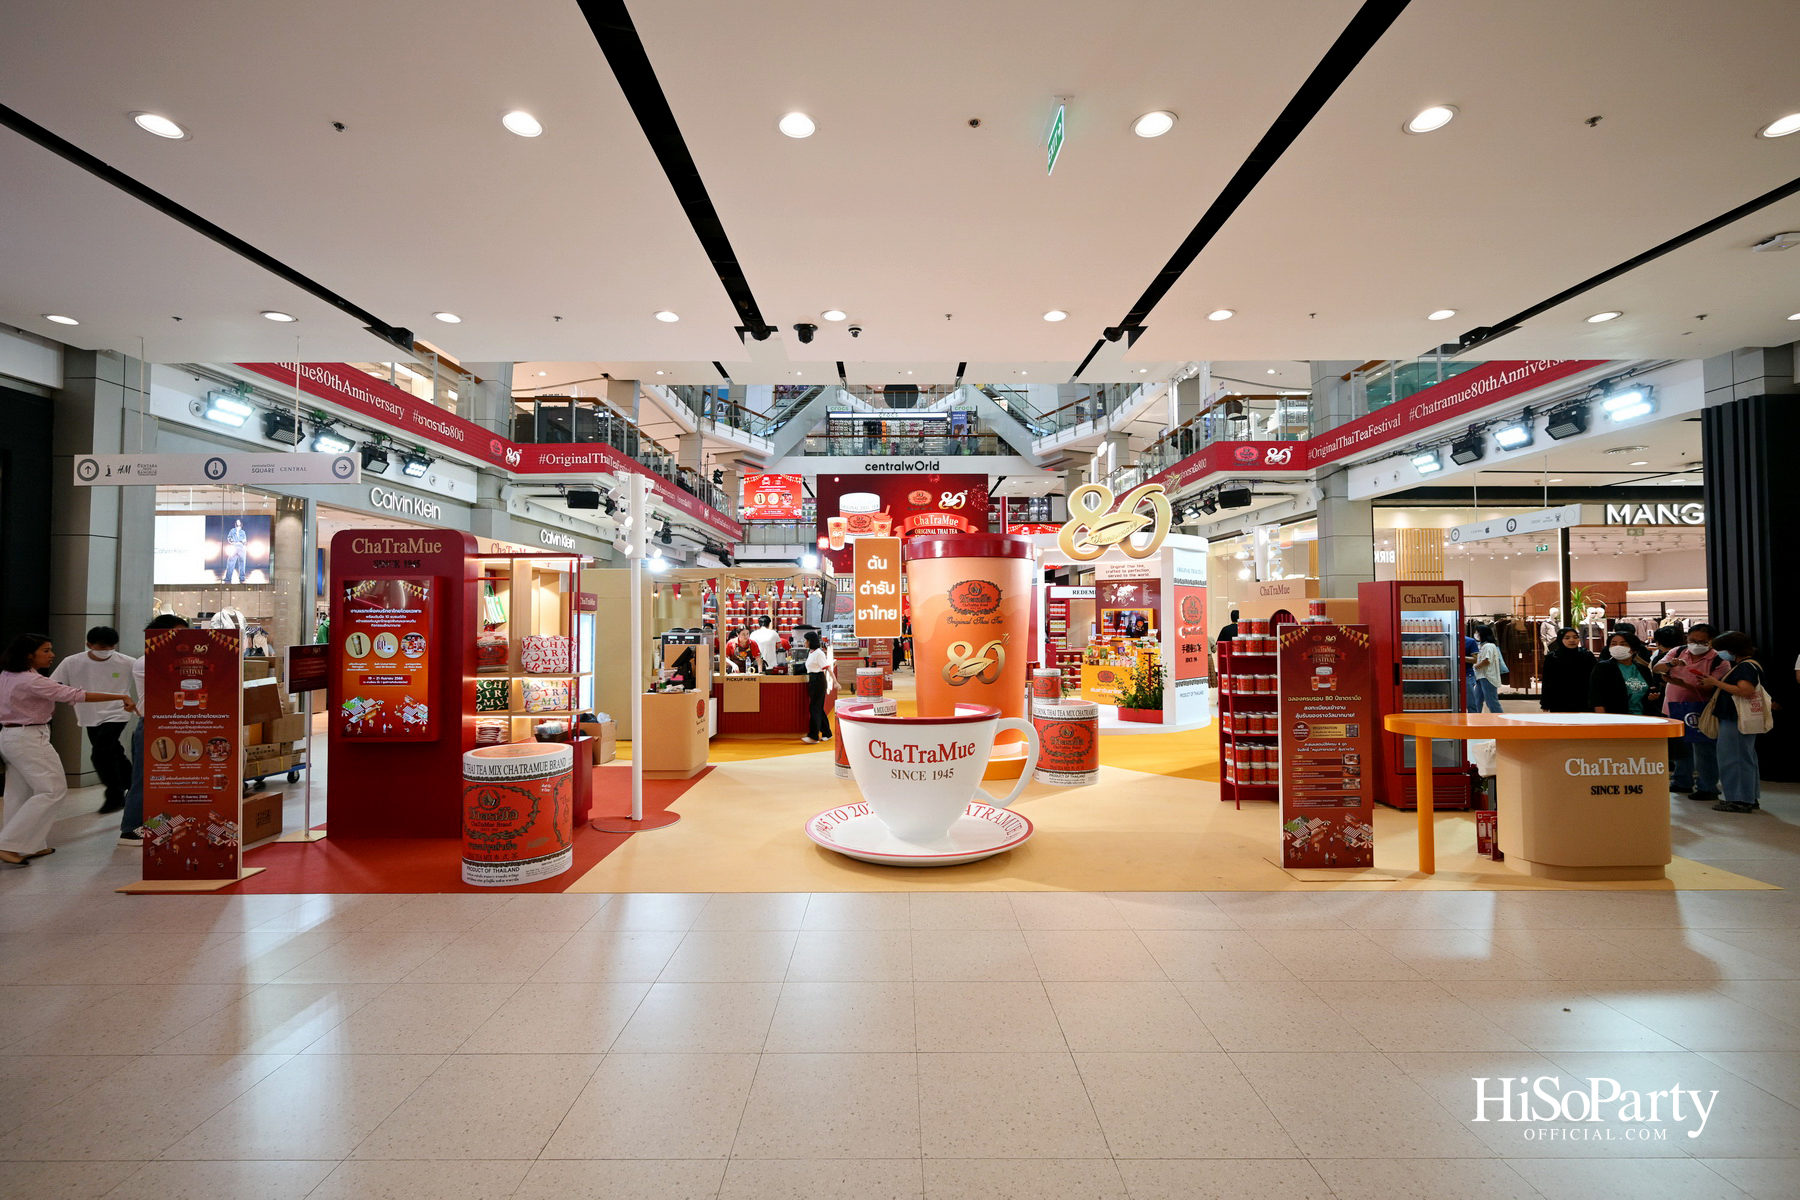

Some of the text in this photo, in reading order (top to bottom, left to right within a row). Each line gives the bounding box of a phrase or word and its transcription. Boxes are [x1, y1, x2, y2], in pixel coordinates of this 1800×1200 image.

[412, 409, 464, 442] #ชาตรามือ80ปี
[1307, 413, 1402, 460] #OriginalThaiTeaFestival
[865, 461, 940, 471] centralwOrld
[370, 486, 442, 521] Calvin Klein
[914, 515, 959, 526] ChaTraMue
[352, 538, 443, 554] ChaTraMue
[540, 529, 577, 549] Calvin Klein
[867, 555, 888, 570] ต้น
[859, 580, 895, 596] ตำรับ
[1260, 584, 1291, 596] ChaTraMue
[1403, 594, 1456, 604] ChaTraMue
[857, 604, 897, 621] ชาไทย
[946, 617, 972, 627] Original
[972, 616, 989, 625] Thai
[868, 739, 976, 764] ChaTraMue
[475, 764, 488, 775] TEA
[488, 764, 502, 775] MIX
[503, 761, 548, 774] CHATRAMUE
[549, 757, 567, 770] BRAND
[1564, 757, 1665, 776] ChaTraMue
[891, 768, 954, 781] SINCE 1945
[1590, 785, 1643, 795] SINCE 1945
[825, 809, 848, 824] TO
